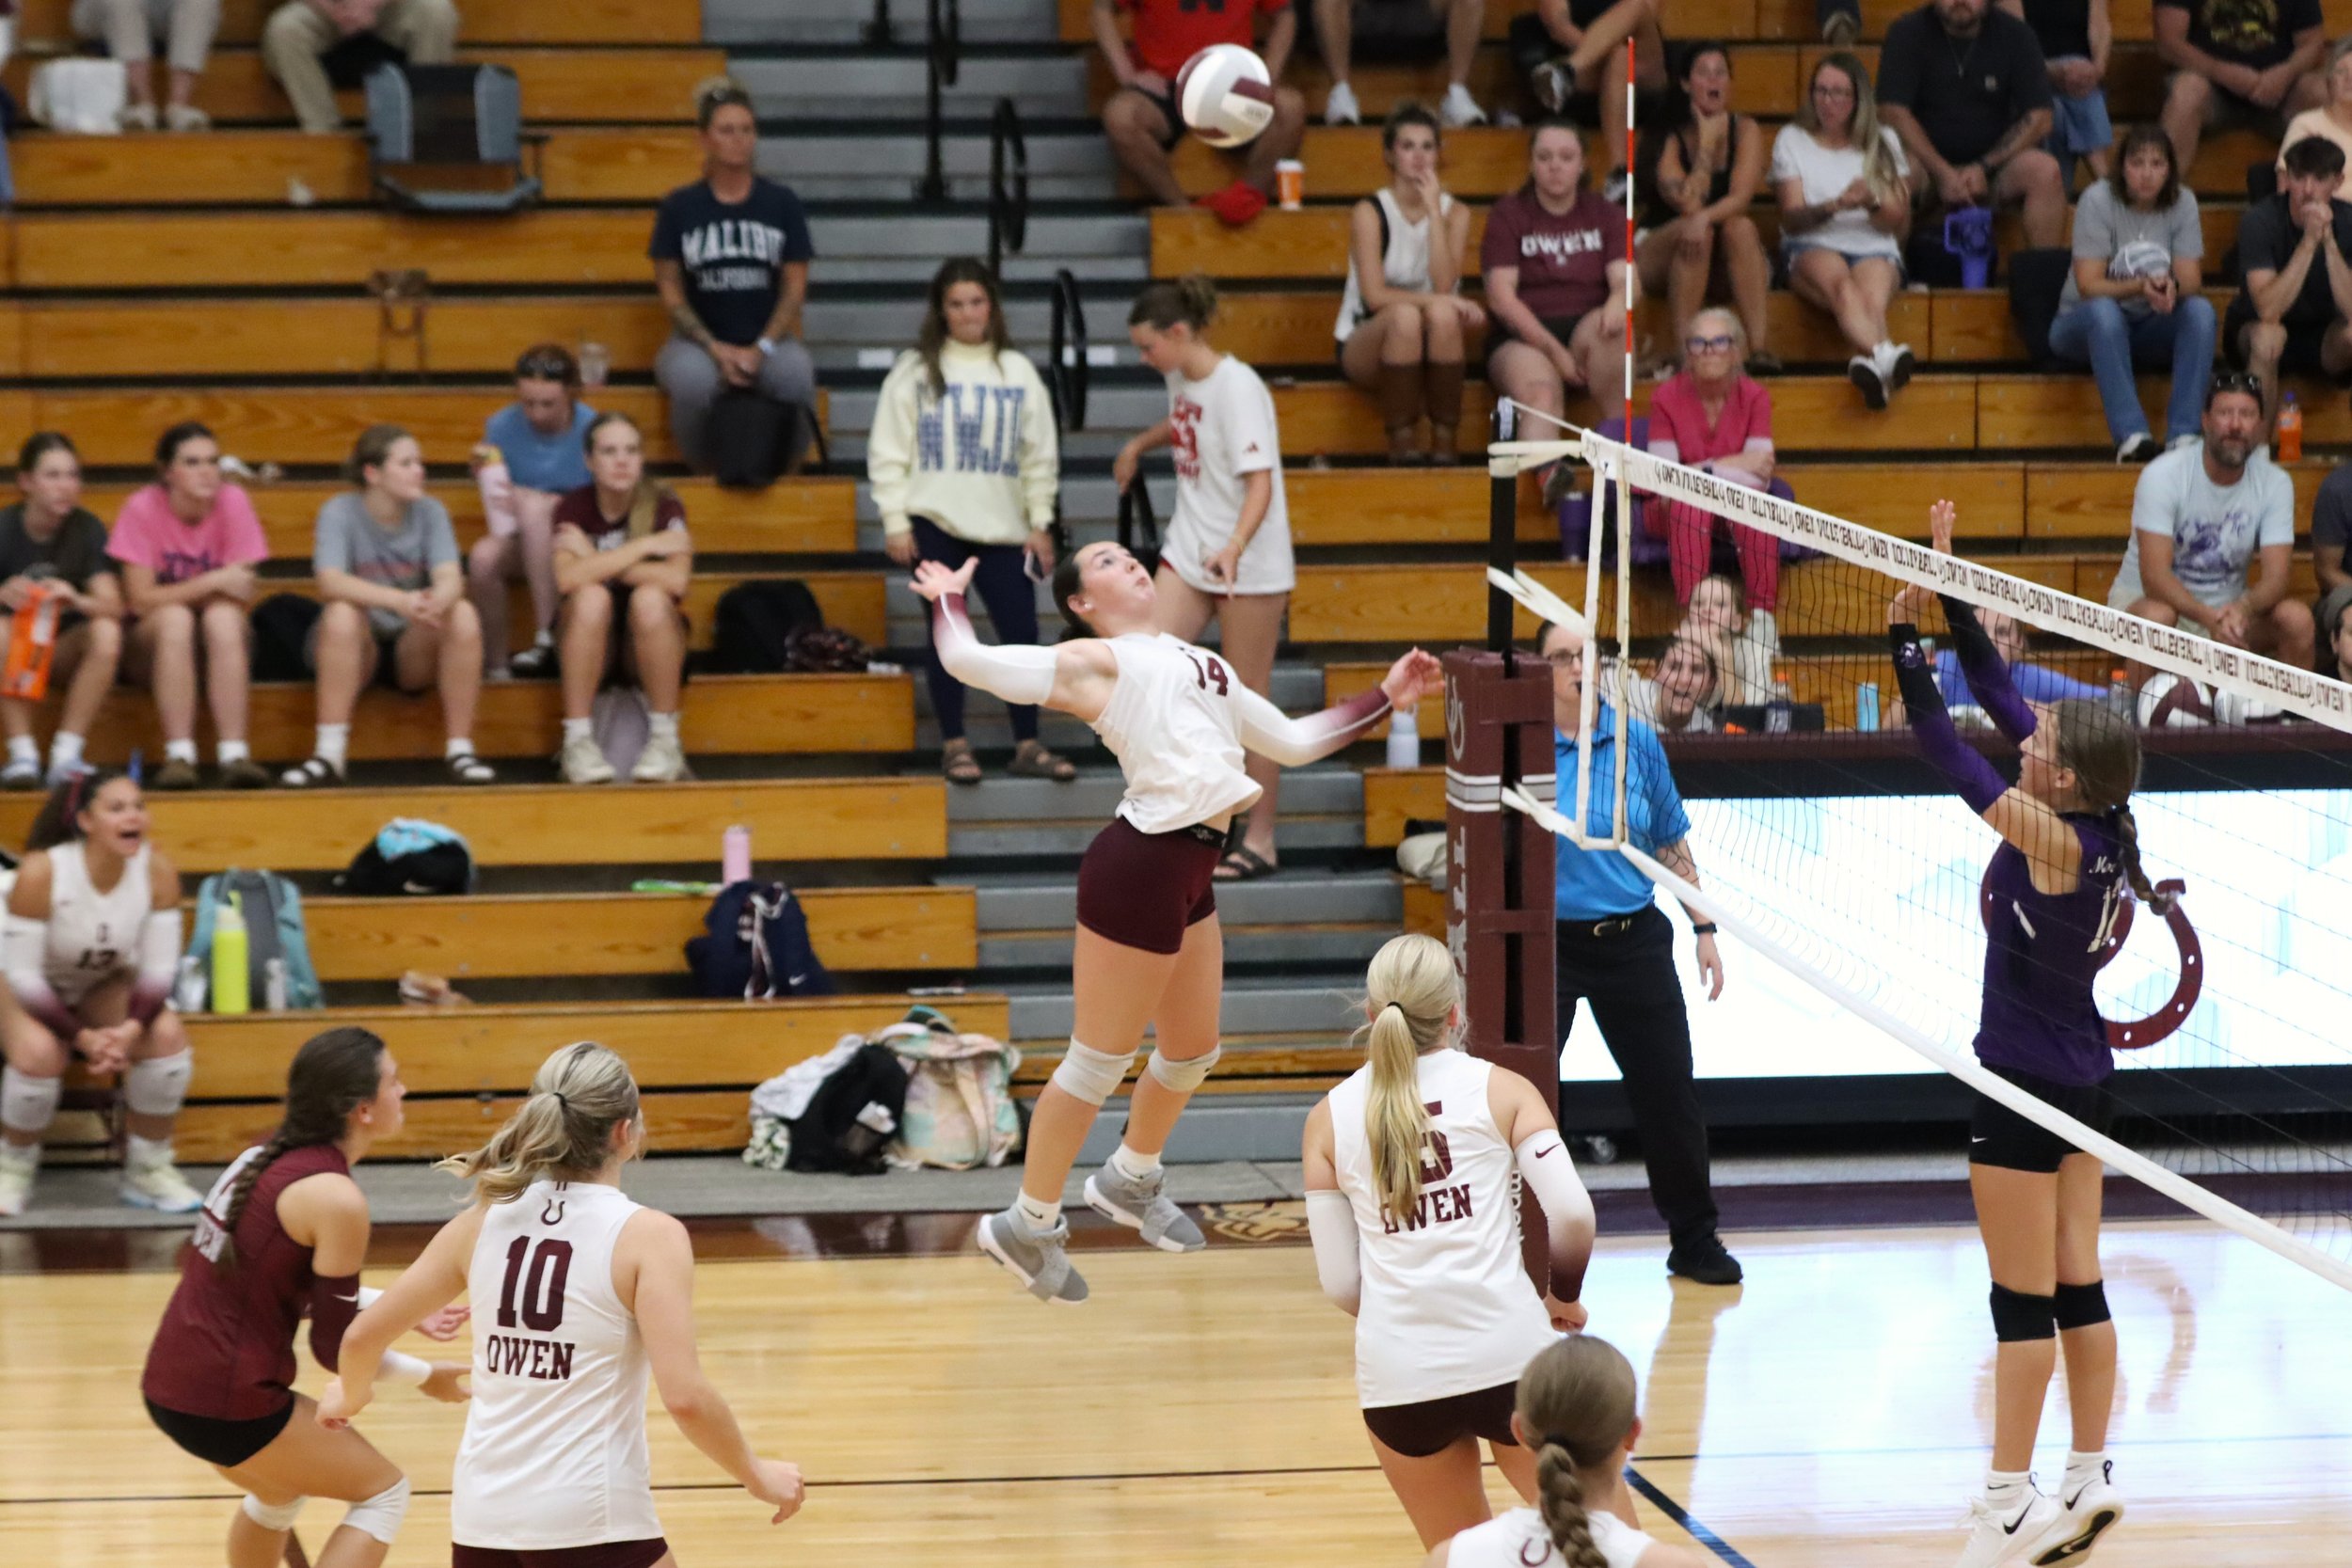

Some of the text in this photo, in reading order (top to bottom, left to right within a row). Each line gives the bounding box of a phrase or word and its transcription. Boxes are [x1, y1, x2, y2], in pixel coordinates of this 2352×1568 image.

[1521, 228, 1602, 257] OWEN
[2118, 617, 2144, 645] OWEN
[1185, 656, 1229, 697] 14
[497, 1235, 573, 1332] 10
[487, 1334, 575, 1380] OWEN
